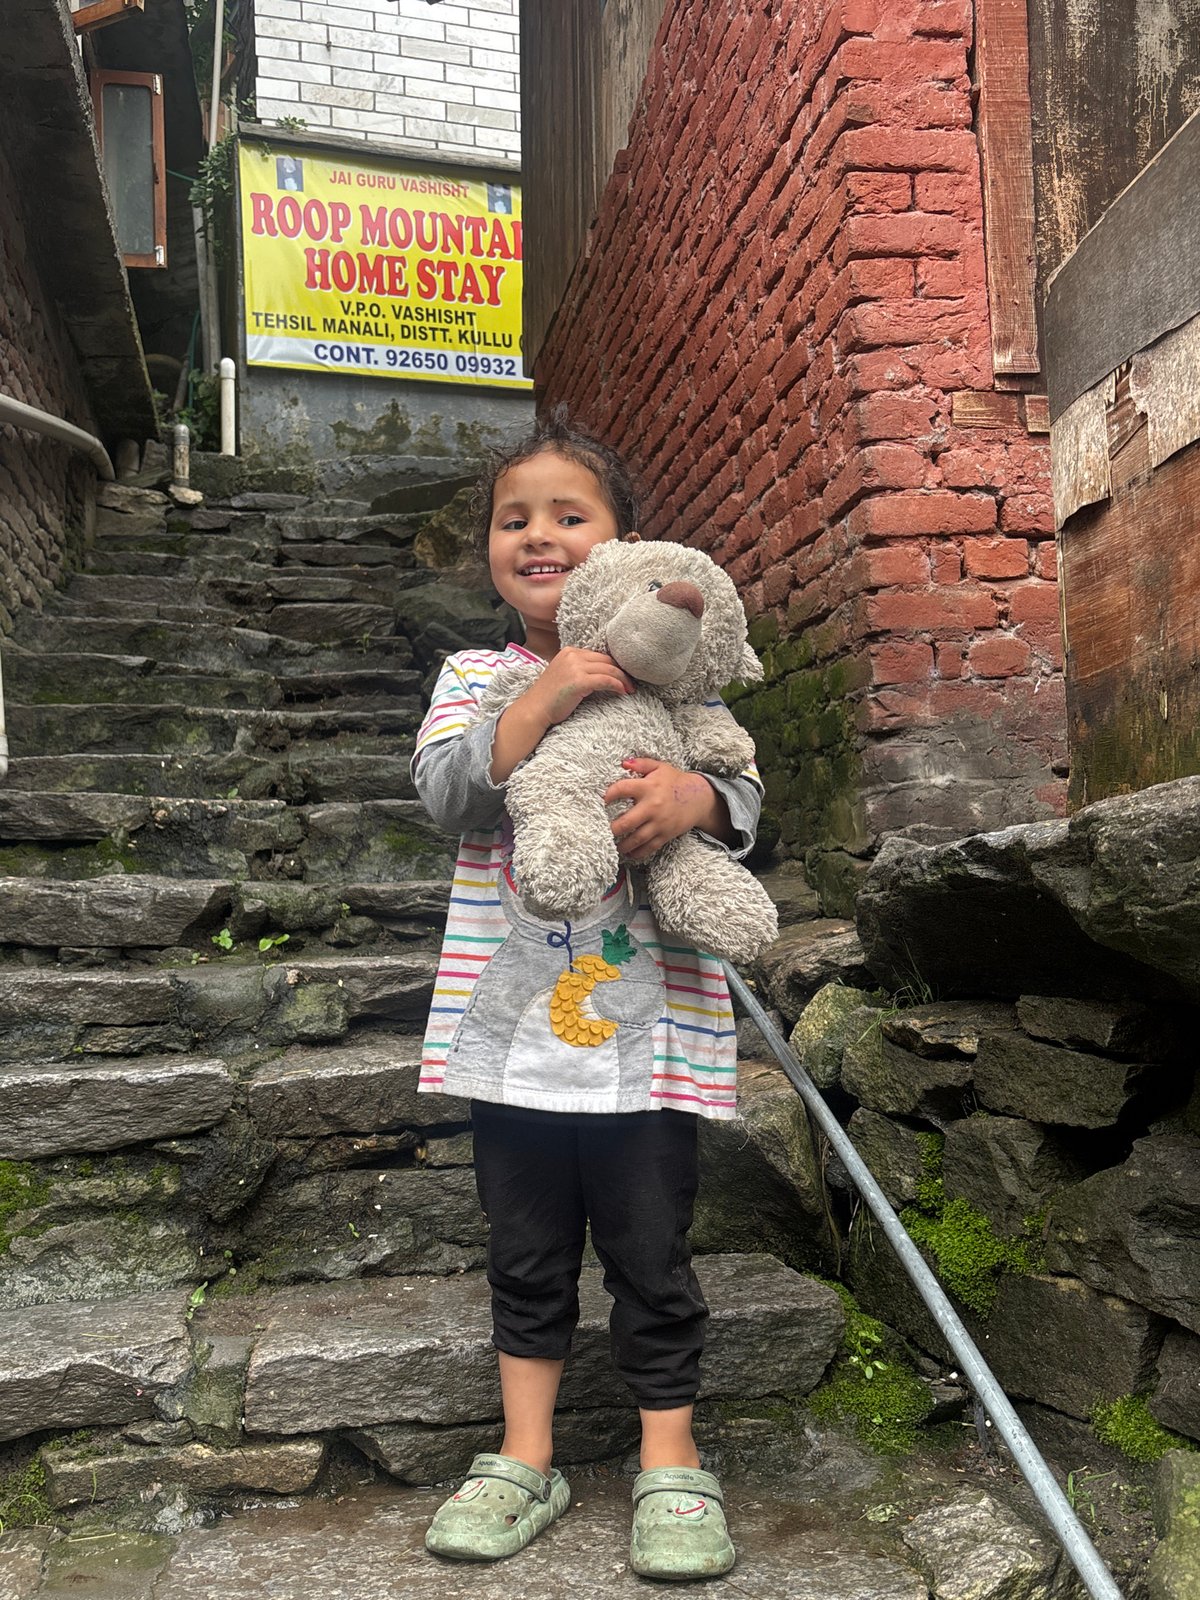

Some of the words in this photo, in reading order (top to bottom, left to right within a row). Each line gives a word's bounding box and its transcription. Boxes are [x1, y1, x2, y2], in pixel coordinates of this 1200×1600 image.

[329, 171, 351, 185] JAI
[357, 173, 396, 190] GURU
[401, 178, 469, 198] VASHISHT
[250, 193, 350, 242] ROOP
[359, 204, 522, 260] MOUNTAI
[304, 248, 409, 297] HOME
[417, 258, 505, 305] STAY
[252, 312, 316, 331] TEHSIL
[323, 319, 395, 341] MANALI,
[401, 324, 452, 343] DISTT.
[459, 330, 512, 348] KULLU
[340, 301, 386, 319] V.P.O.
[391, 305, 476, 326] VASHISHT
[314, 343, 378, 365] CONT.
[386, 350, 448, 370] 92650
[456, 355, 516, 376] 09932
